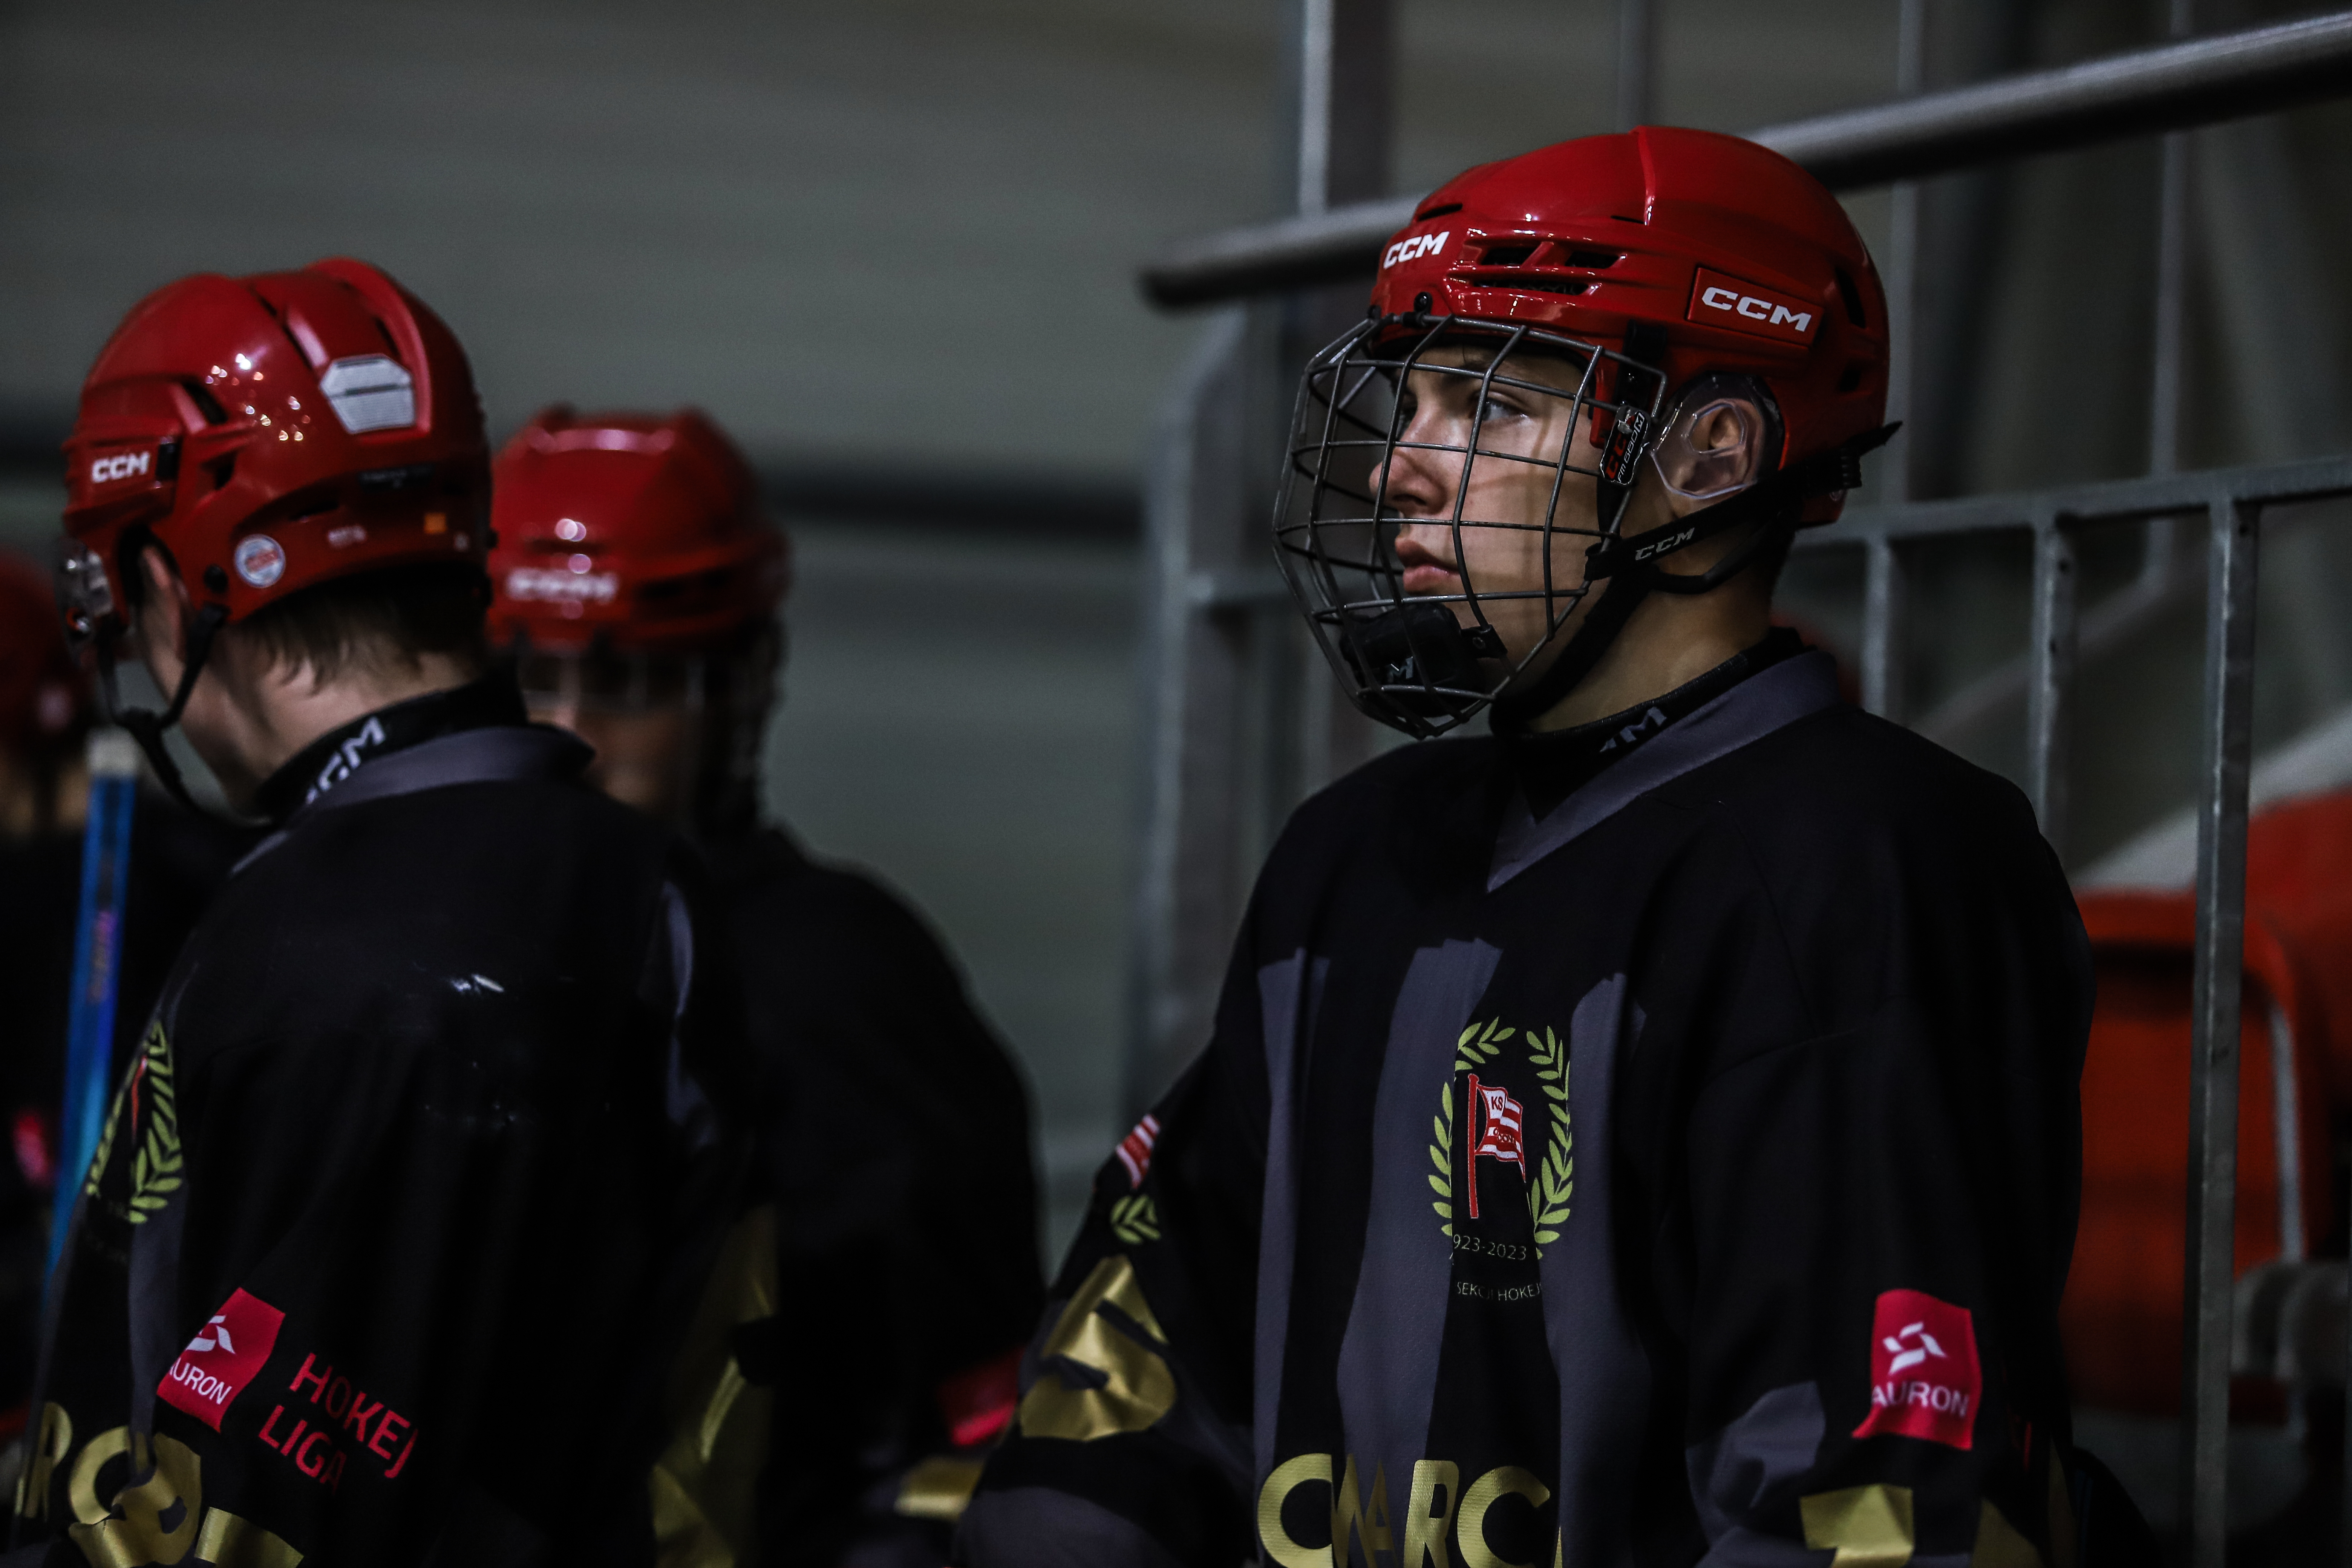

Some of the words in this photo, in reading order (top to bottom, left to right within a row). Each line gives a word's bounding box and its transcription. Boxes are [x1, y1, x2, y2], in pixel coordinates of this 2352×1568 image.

[1383, 231, 1450, 270] CCM
[1701, 286, 1812, 332] CCM
[91, 451, 151, 484] CCM
[1635, 527, 1695, 561] CCM
[1491, 1096, 1503, 1111] KS
[1498, 1282, 1541, 1301] HOKEJ
[289, 1352, 420, 1479] HOKEJ
[257, 1404, 347, 1495] LIGA
